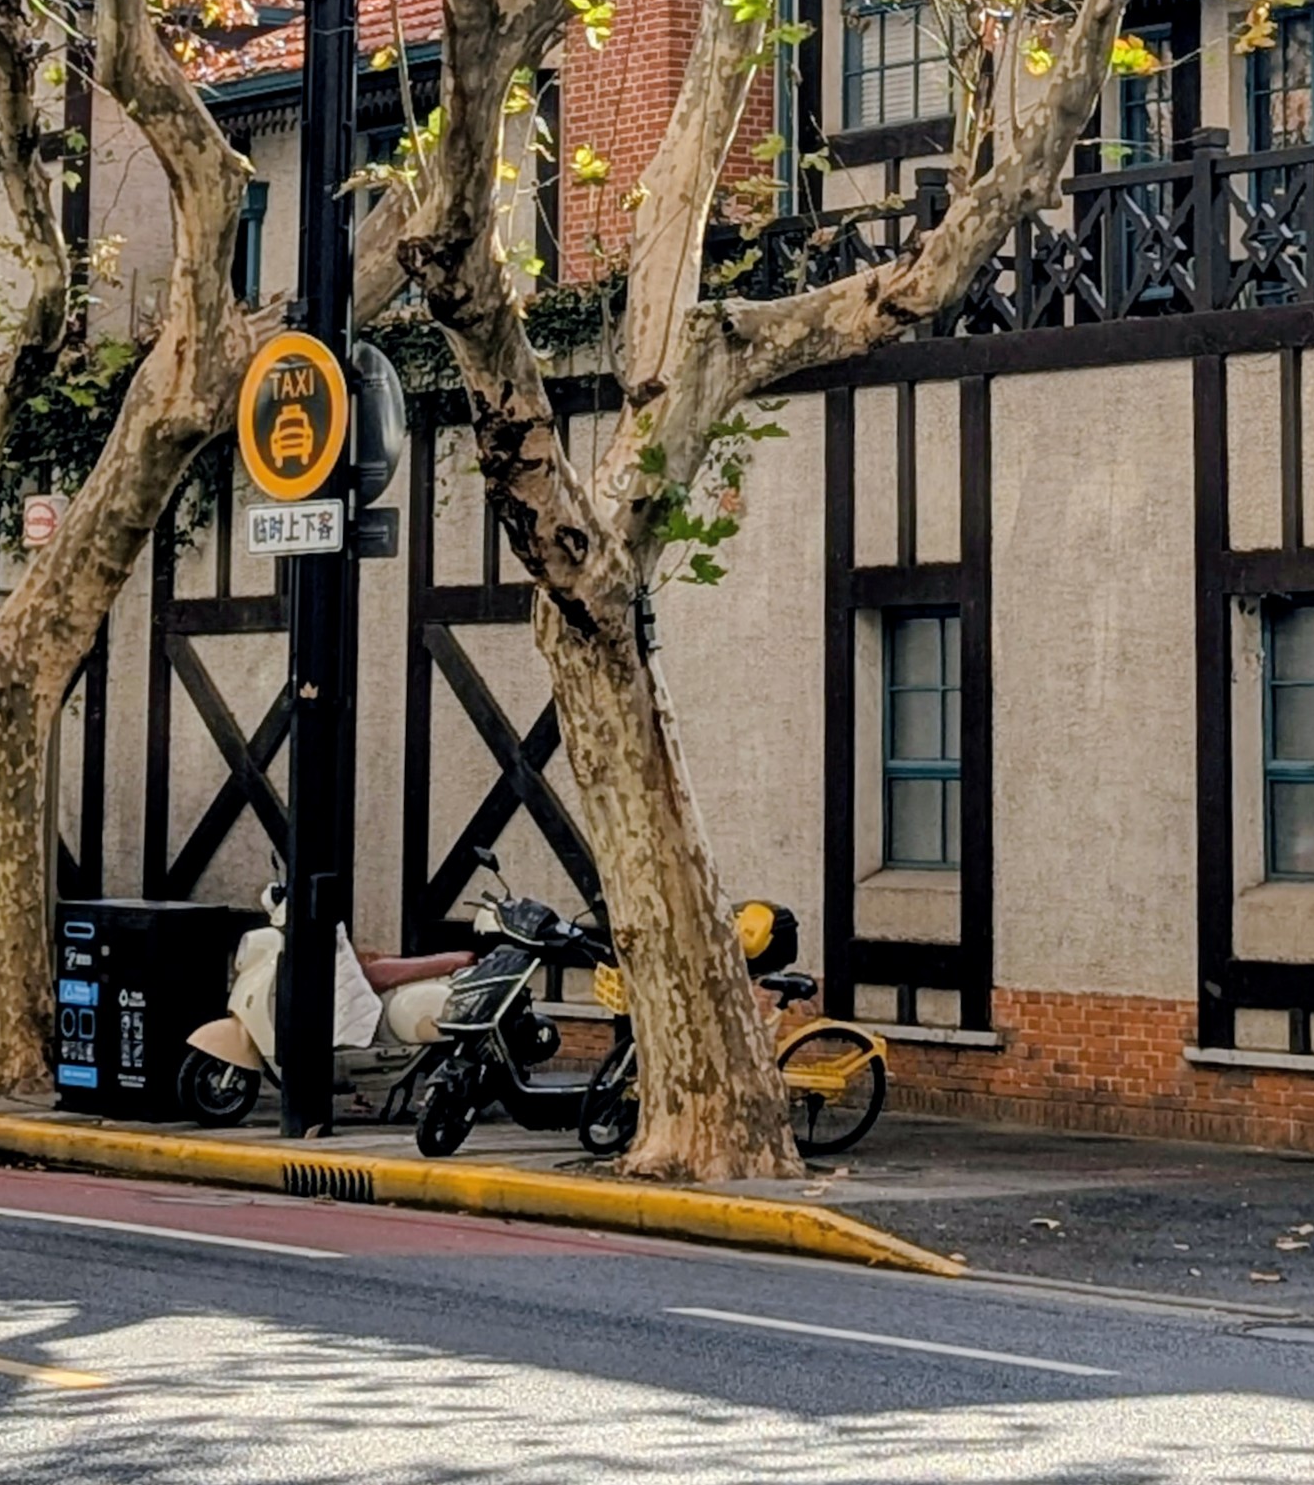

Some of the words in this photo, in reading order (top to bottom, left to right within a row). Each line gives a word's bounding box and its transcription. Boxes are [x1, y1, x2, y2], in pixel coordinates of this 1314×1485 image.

[269, 368, 314, 401] TAXI
[253, 511, 333, 544] 临时上下客
